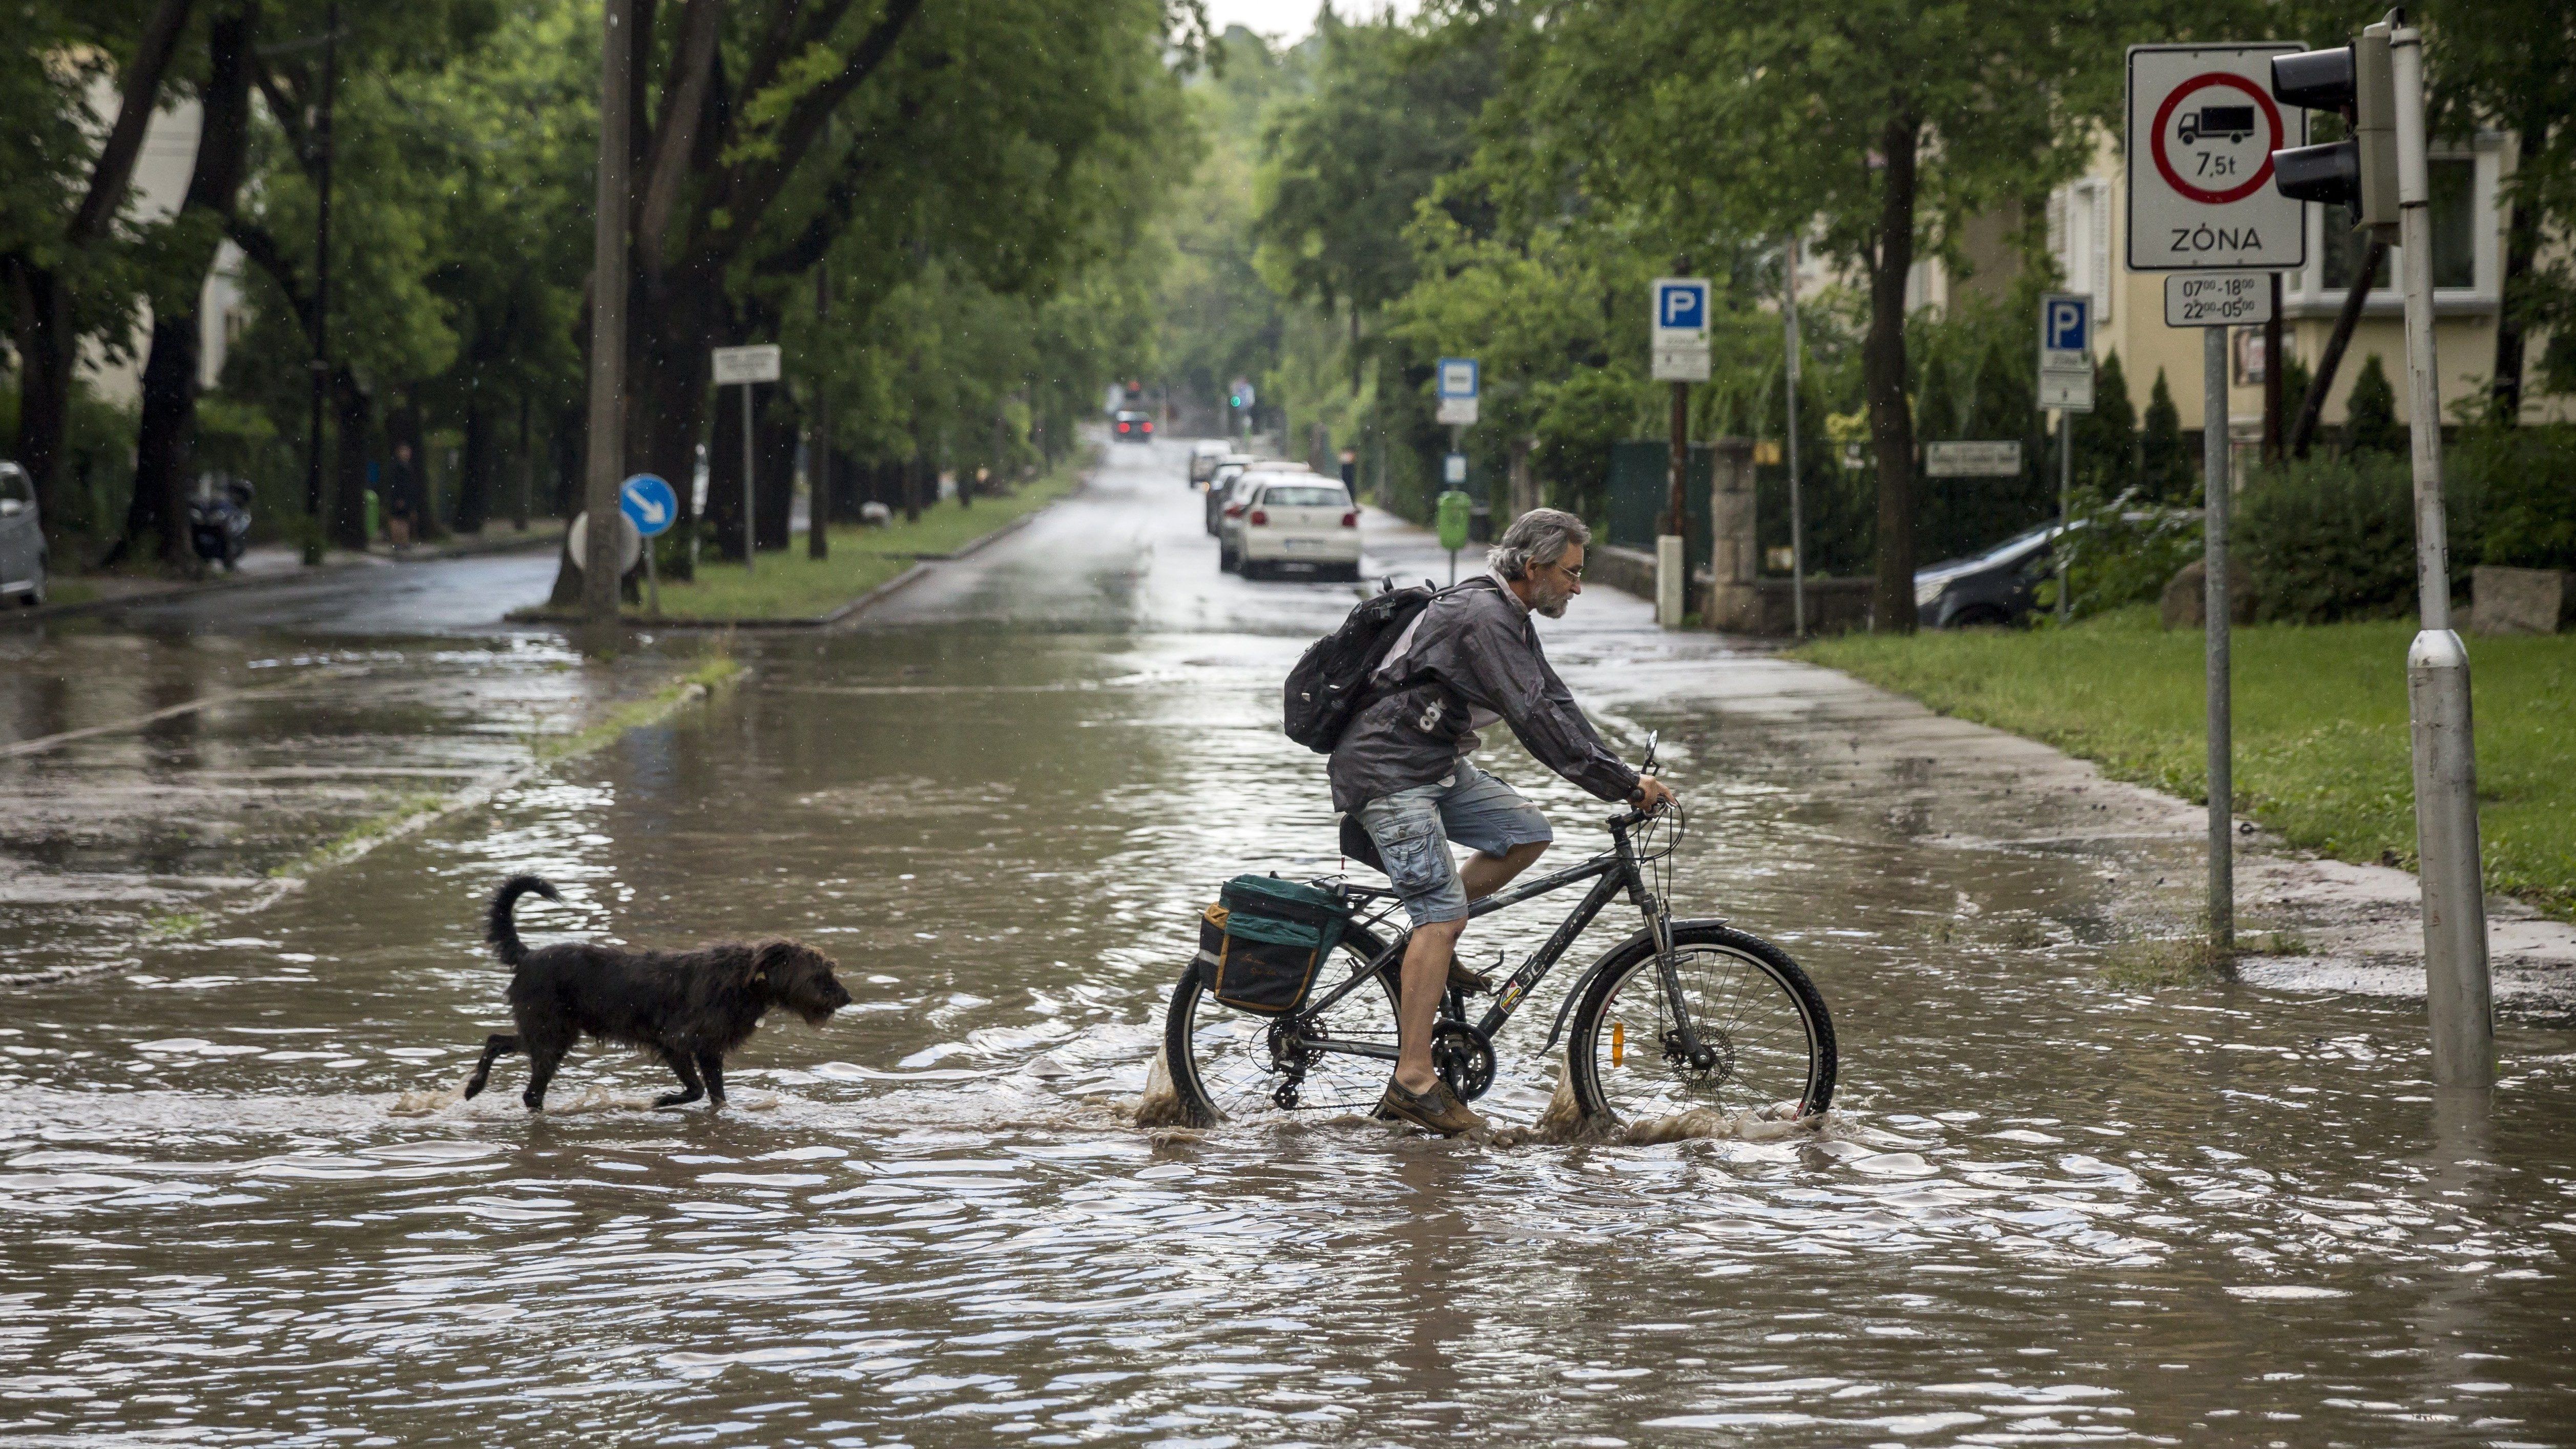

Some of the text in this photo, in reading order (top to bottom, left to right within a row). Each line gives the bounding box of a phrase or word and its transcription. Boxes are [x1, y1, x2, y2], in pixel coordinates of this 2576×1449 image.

[2171, 222, 2262, 251] ZÓNA
[1667, 291, 1696, 323] P
[2053, 305, 2080, 347] P
